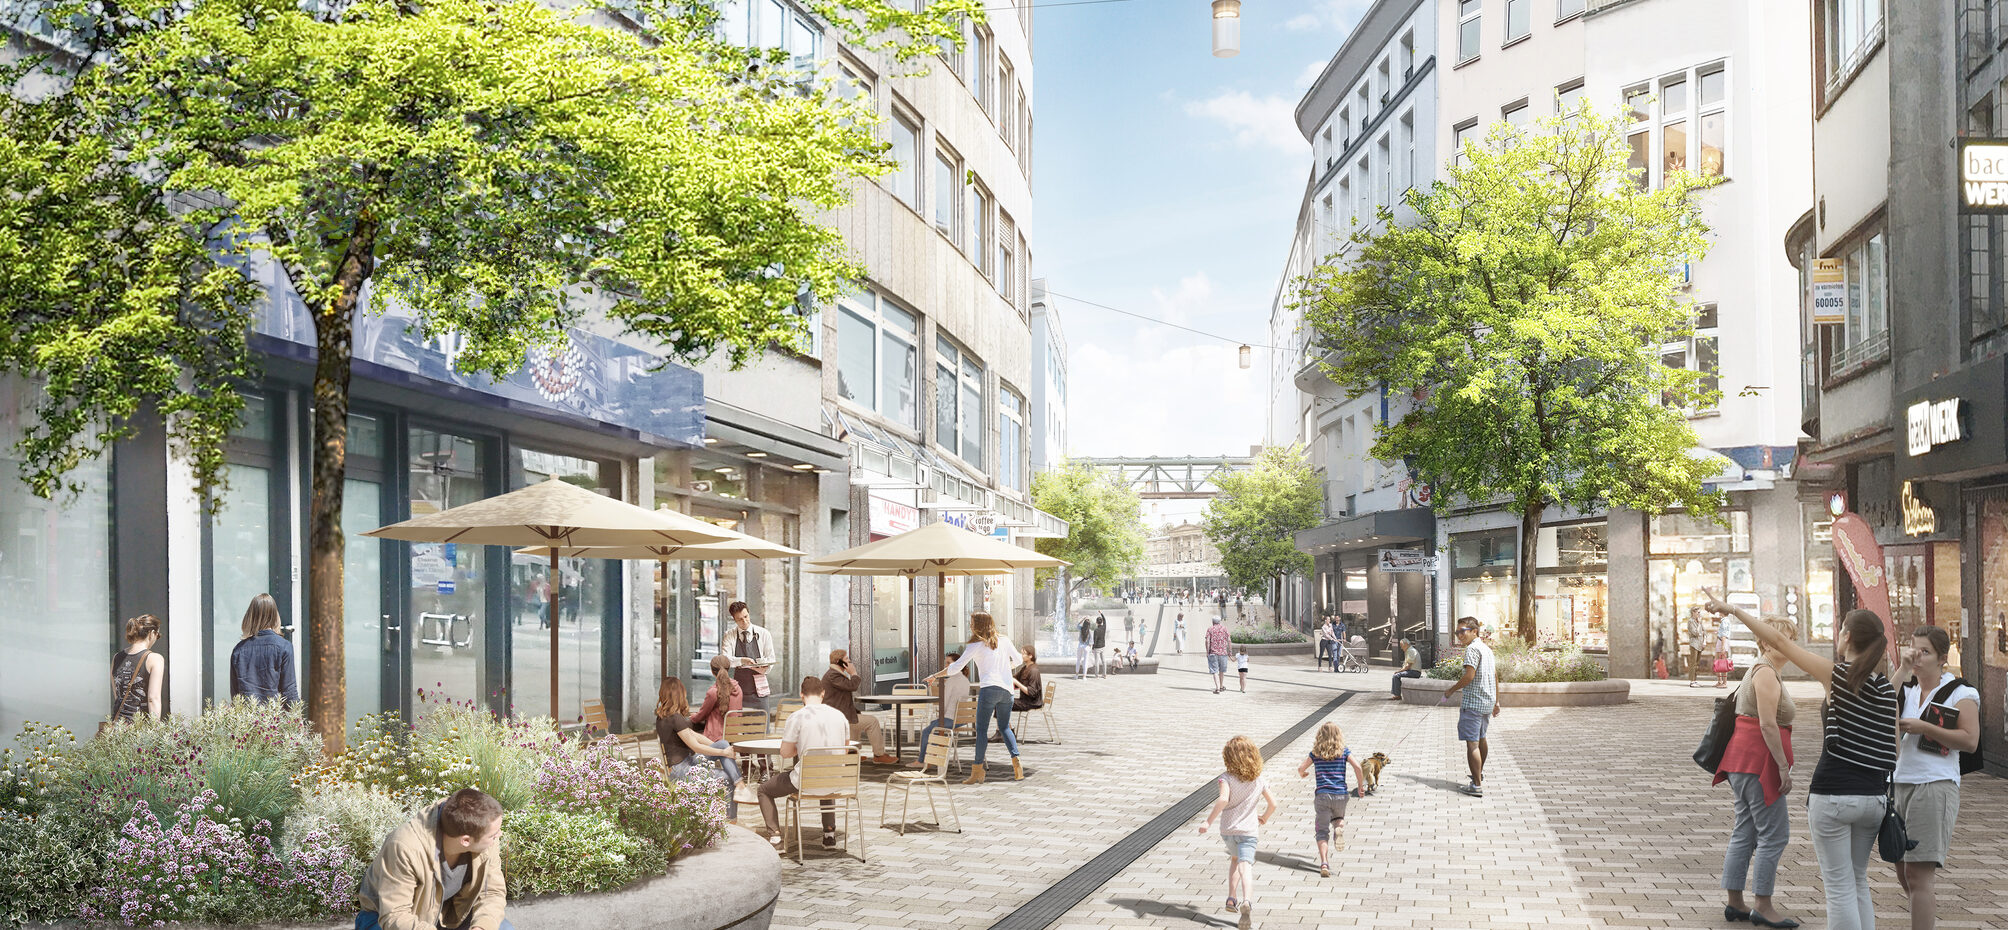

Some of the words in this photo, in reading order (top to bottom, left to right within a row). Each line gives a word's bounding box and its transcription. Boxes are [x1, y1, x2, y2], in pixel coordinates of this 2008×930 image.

[1815, 297, 1844, 308] 600055
[1930, 397, 1960, 445] WERK
[975, 515, 994, 526] coffee
[983, 525, 991, 533] go
